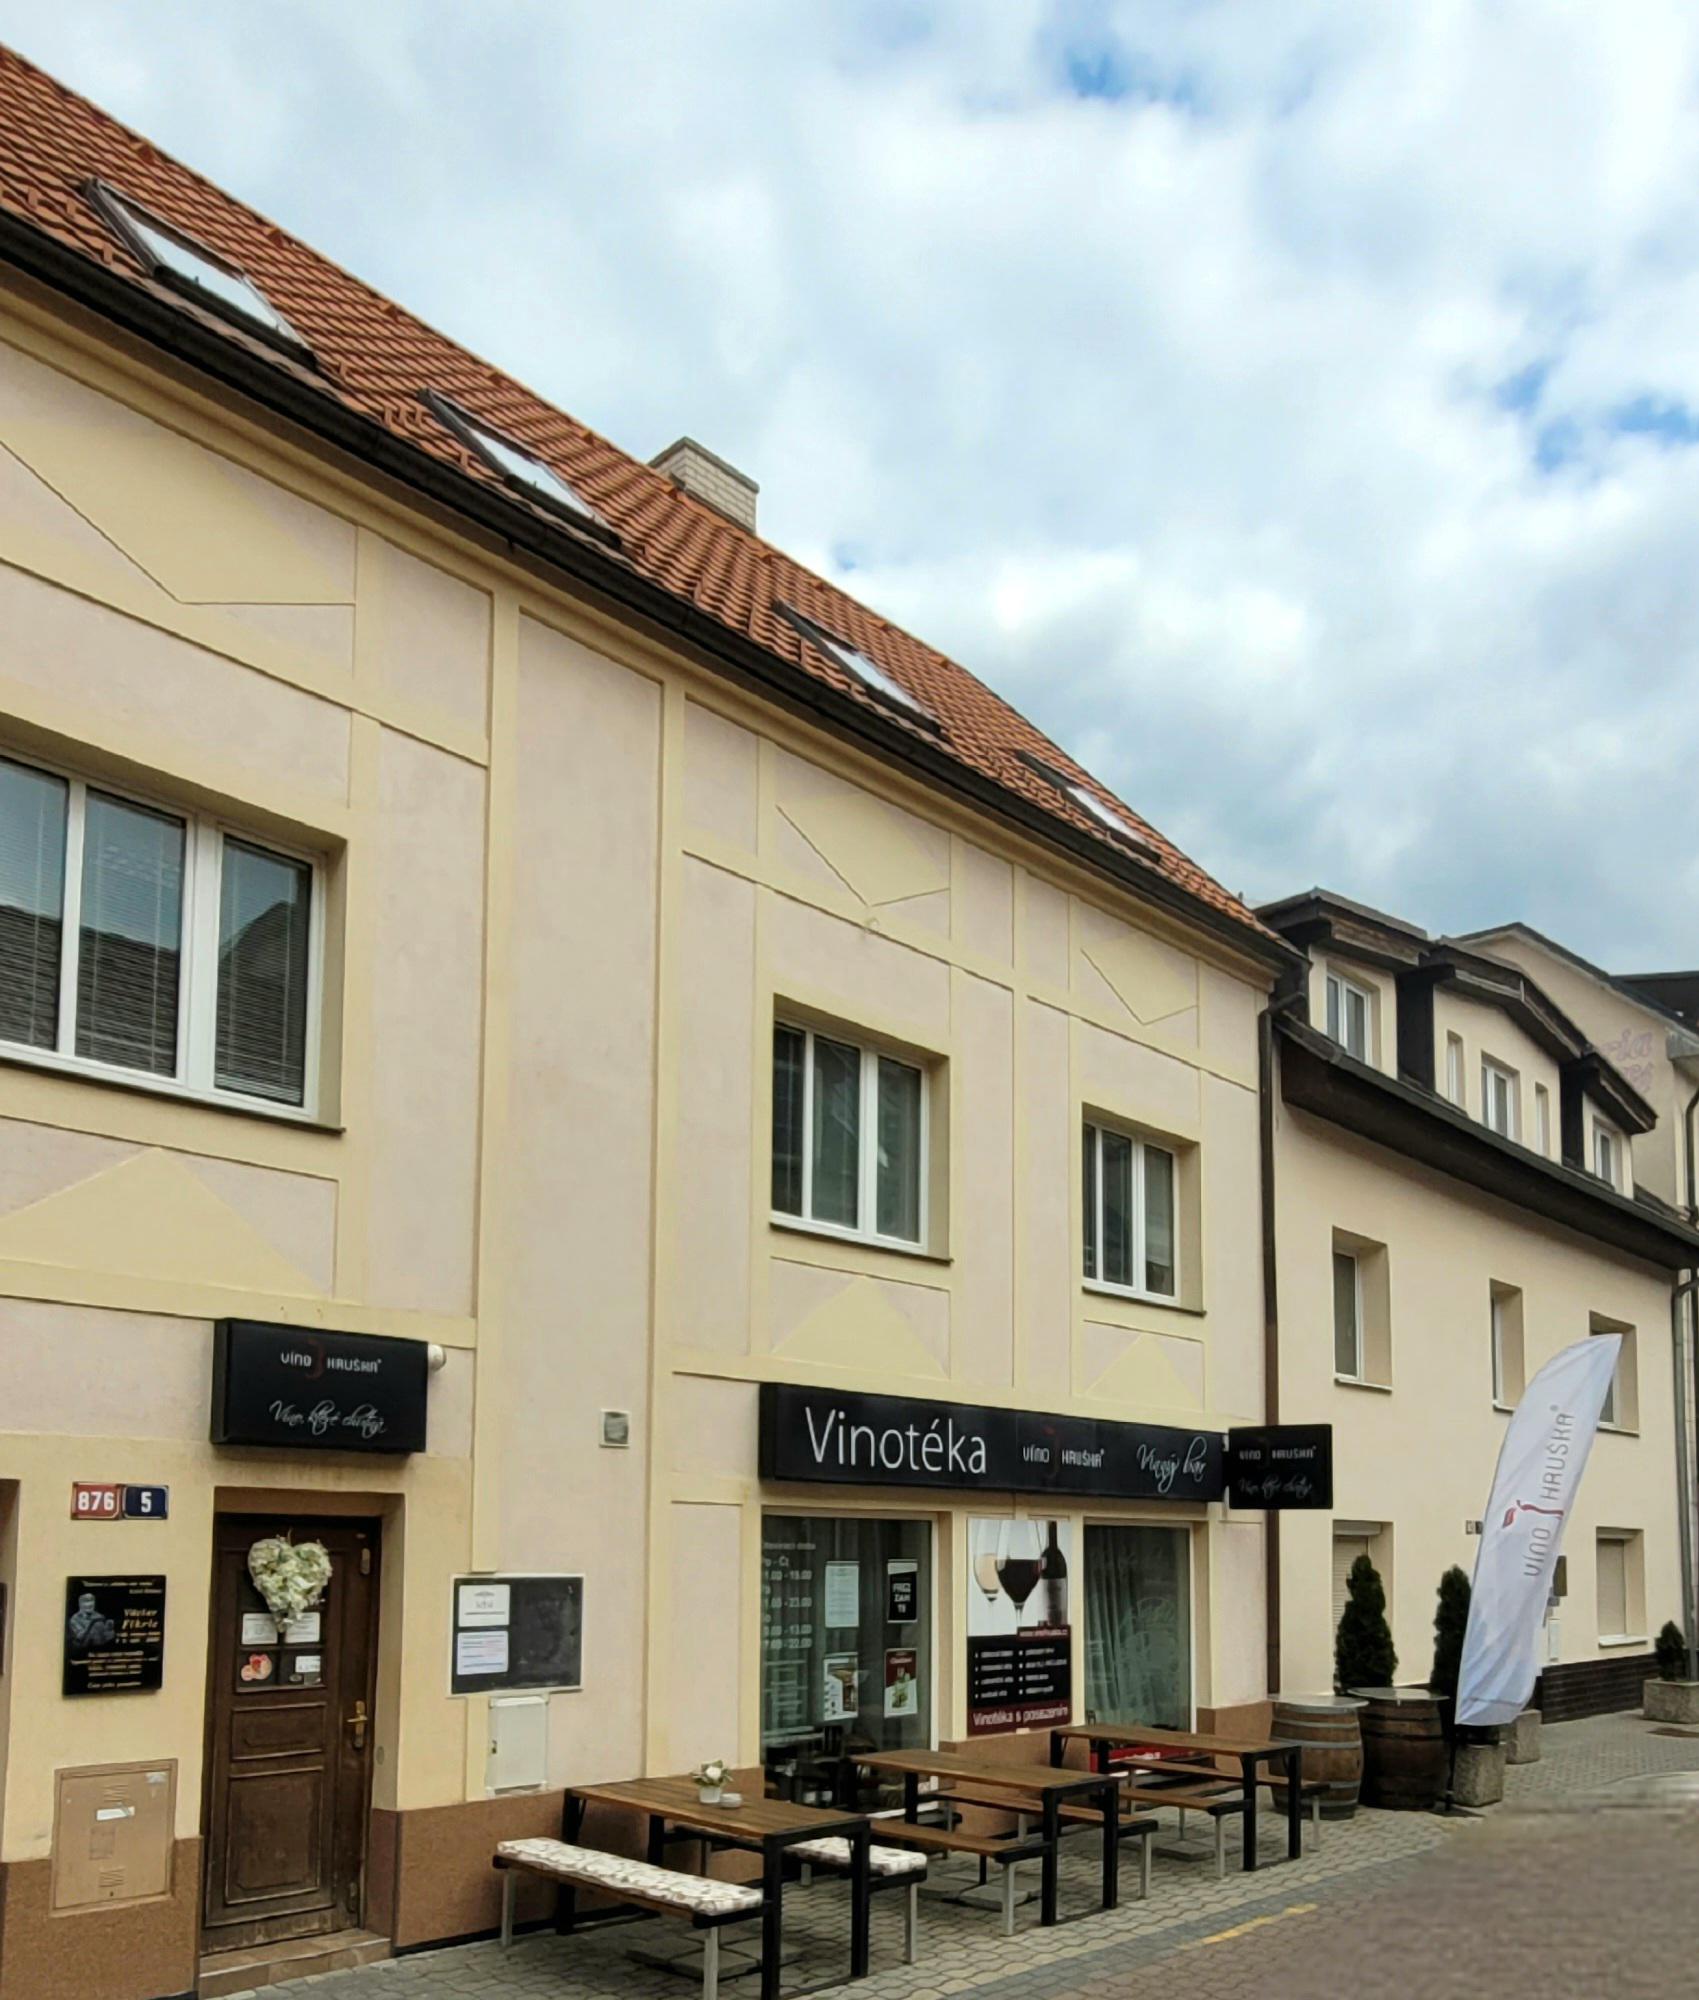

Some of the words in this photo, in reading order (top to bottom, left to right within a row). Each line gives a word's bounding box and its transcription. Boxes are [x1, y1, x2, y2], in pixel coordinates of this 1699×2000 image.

[805, 1406, 986, 1474] Vinotéka
[78, 1491, 115, 1511] 876
[141, 1491, 152, 1513] 5
